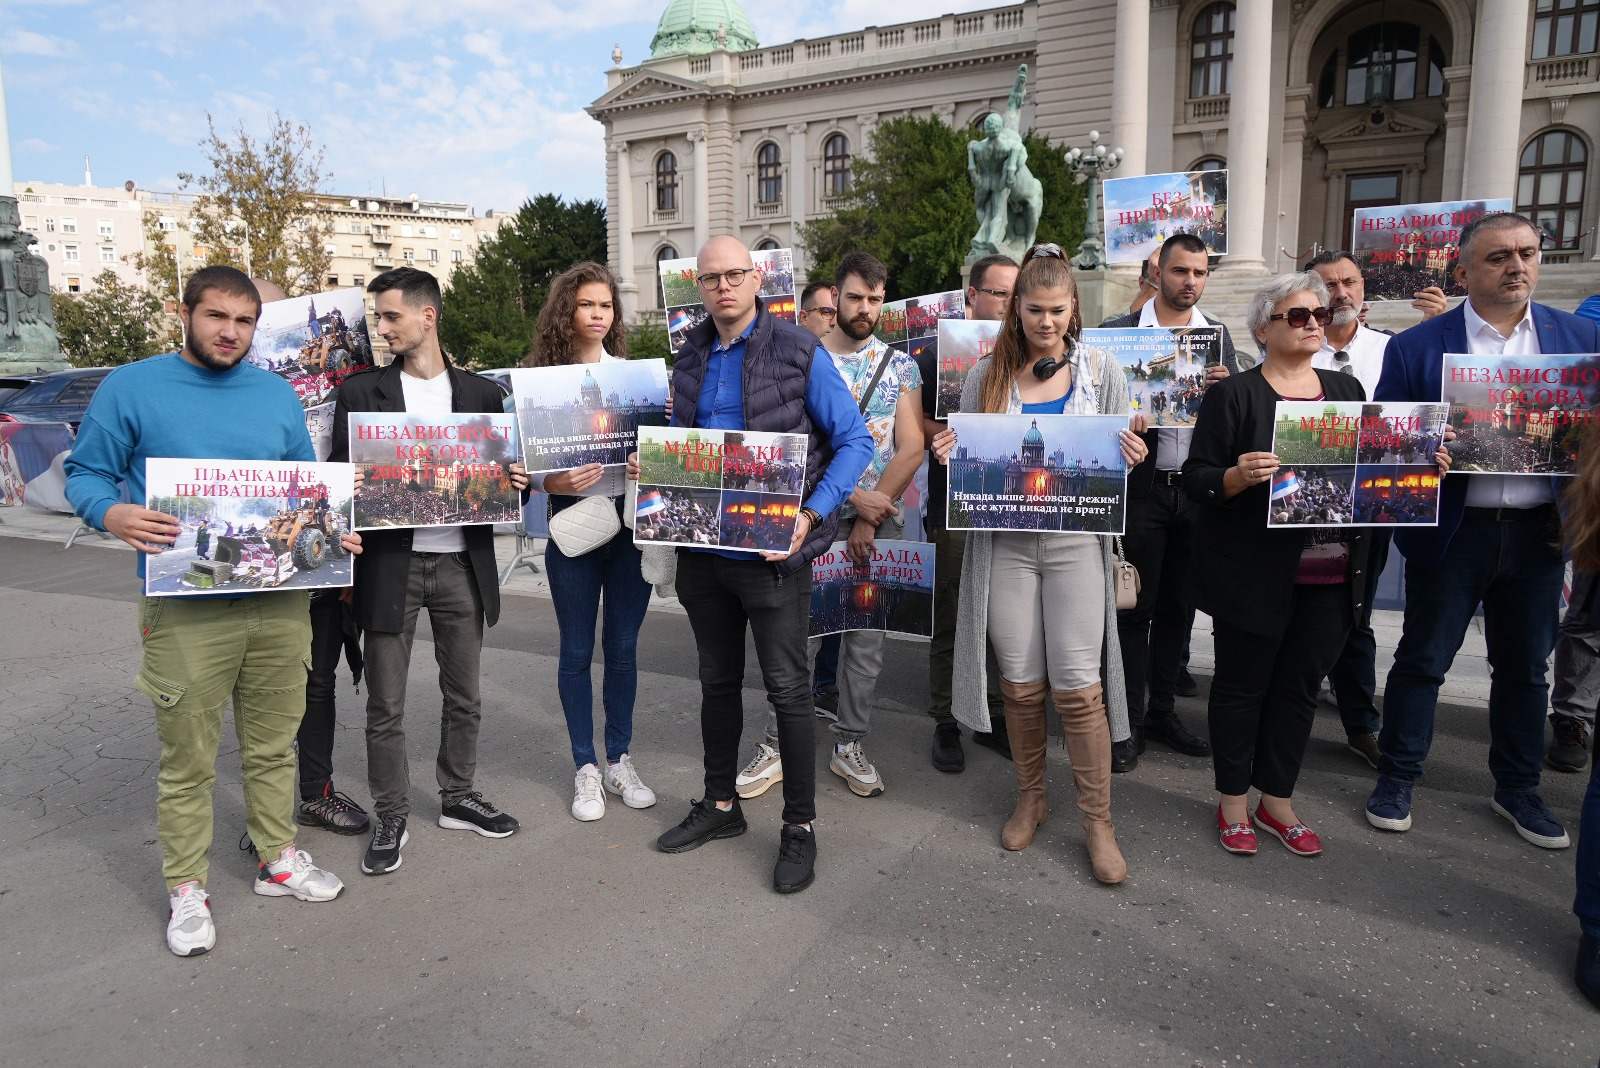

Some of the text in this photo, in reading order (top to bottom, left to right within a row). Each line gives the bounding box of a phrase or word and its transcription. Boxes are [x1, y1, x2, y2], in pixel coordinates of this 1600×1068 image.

[1392, 229, 1461, 245] КОСОВ
[1182, 332, 1217, 344] режим!
[1300, 415, 1421, 433] МАРТОВСКИ
[357, 424, 512, 442] НЕЗАВИСНОСТ
[528, 430, 636, 446] Никада више досовски
[395, 444, 481, 461] КОСОВА
[535, 444, 550, 456] Да
[550, 445, 561, 454] се
[562, 443, 588, 454] жути
[589, 441, 622, 451] никада
[623, 440, 634, 448] не
[664, 439, 785, 462] МАРТОВСКИ
[194, 467, 316, 483] ПЉАЧКАШКЕ
[953, 491, 1119, 505] Никада више досовски режим!
[960, 501, 975, 513] Да
[976, 504, 988, 512] се
[988, 504, 1018, 514] жути
[1019, 504, 1058, 514] никада
[1059, 506, 1073, 514] не
[1074, 506, 1105, 516] врате
